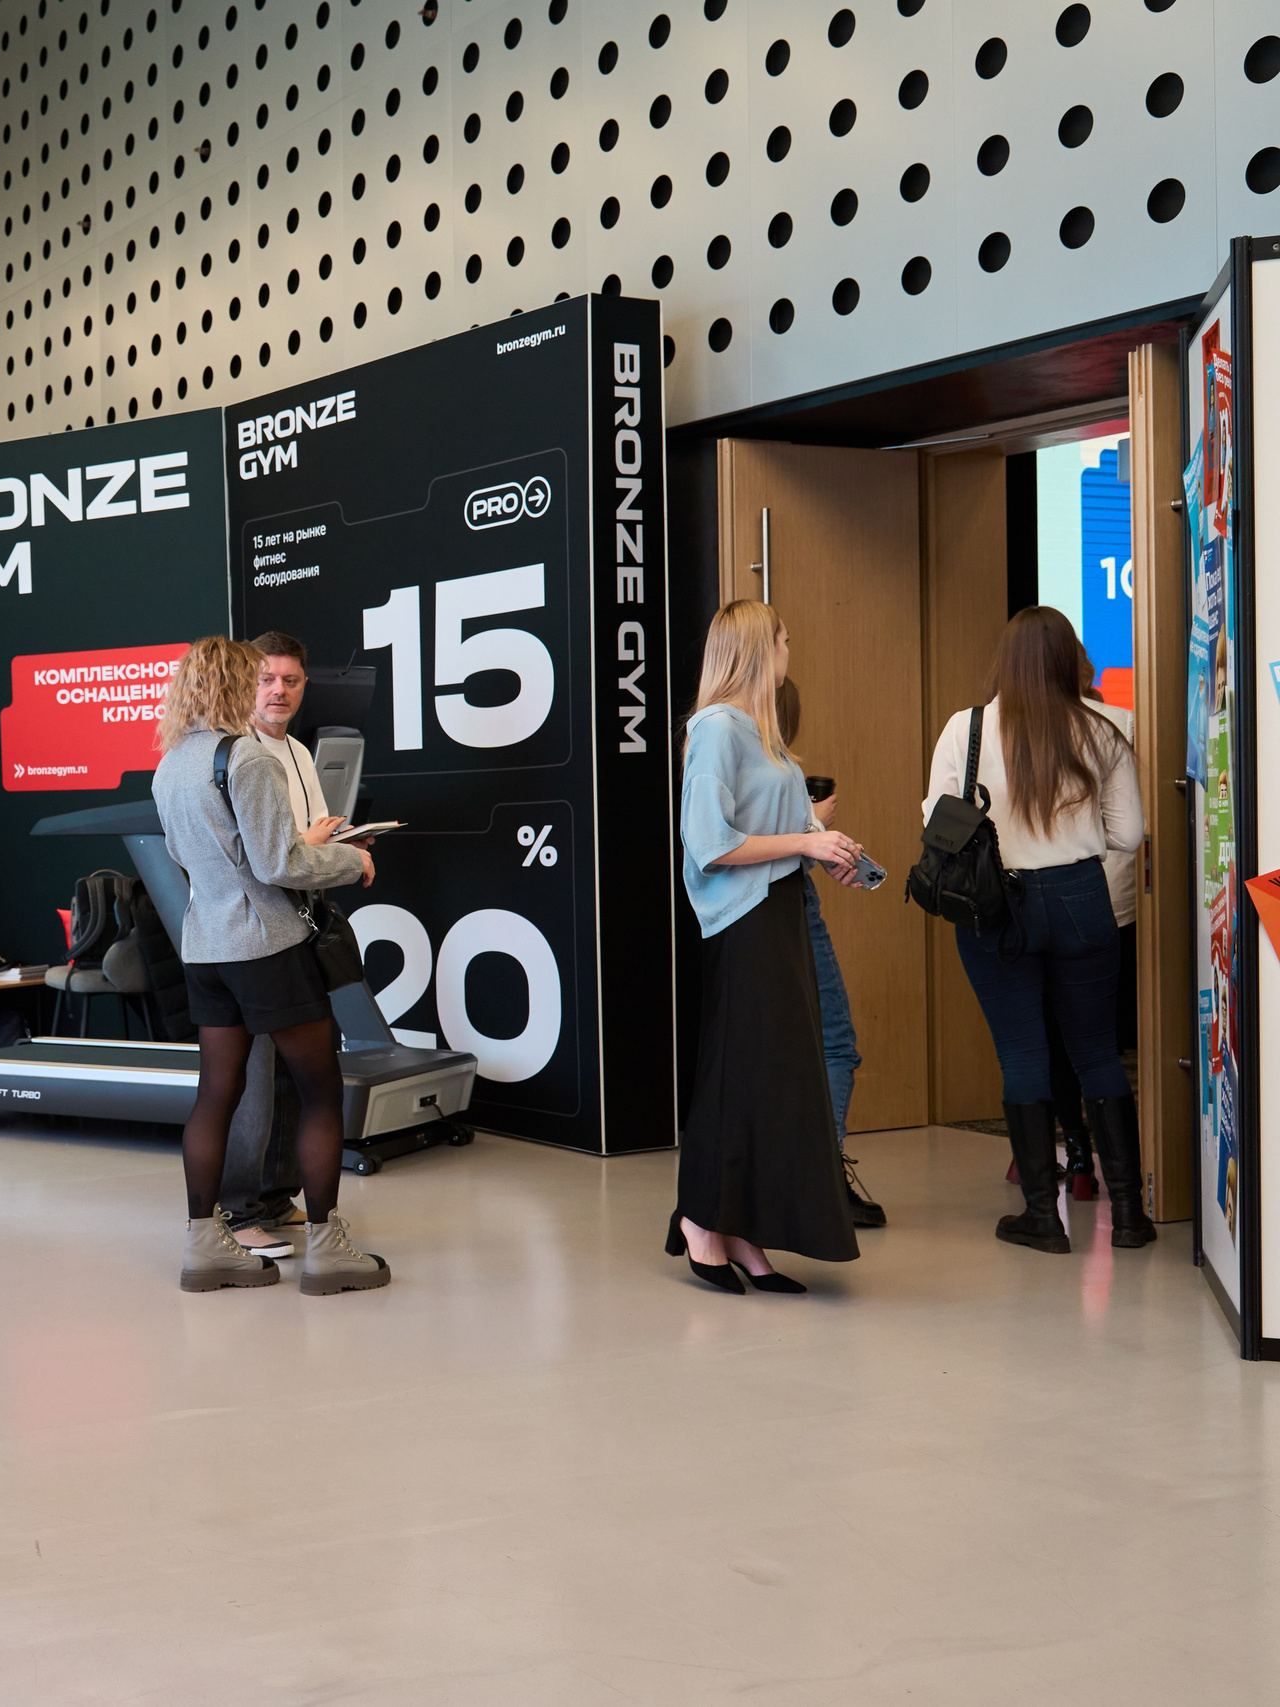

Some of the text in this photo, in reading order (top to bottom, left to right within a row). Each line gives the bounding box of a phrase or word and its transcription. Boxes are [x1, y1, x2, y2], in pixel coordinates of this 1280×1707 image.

[496, 324, 566, 355] bronzegym.ru
[238, 390, 357, 449] BRONZE
[238, 440, 298, 481] GYM
[472, 491, 519, 521] PRO
[253, 524, 327, 549] 15 лет на рынке
[613, 342, 647, 754] BRONZE GYM
[253, 552, 286, 571] фитнес
[254, 565, 320, 587] оборудования
[362, 563, 554, 751] 15
[34, 661, 180, 686] КОМПЛЕКСНОЕ
[56, 683, 172, 704] ОСНАЩЕНИ
[103, 704, 167, 723] КЛУБО
[27, 765, 88, 777] bronzegym.ru
[516, 825, 558, 867] %
[341, 904, 561, 1083] 20
[12, 1089, 40, 1100] TURBO
